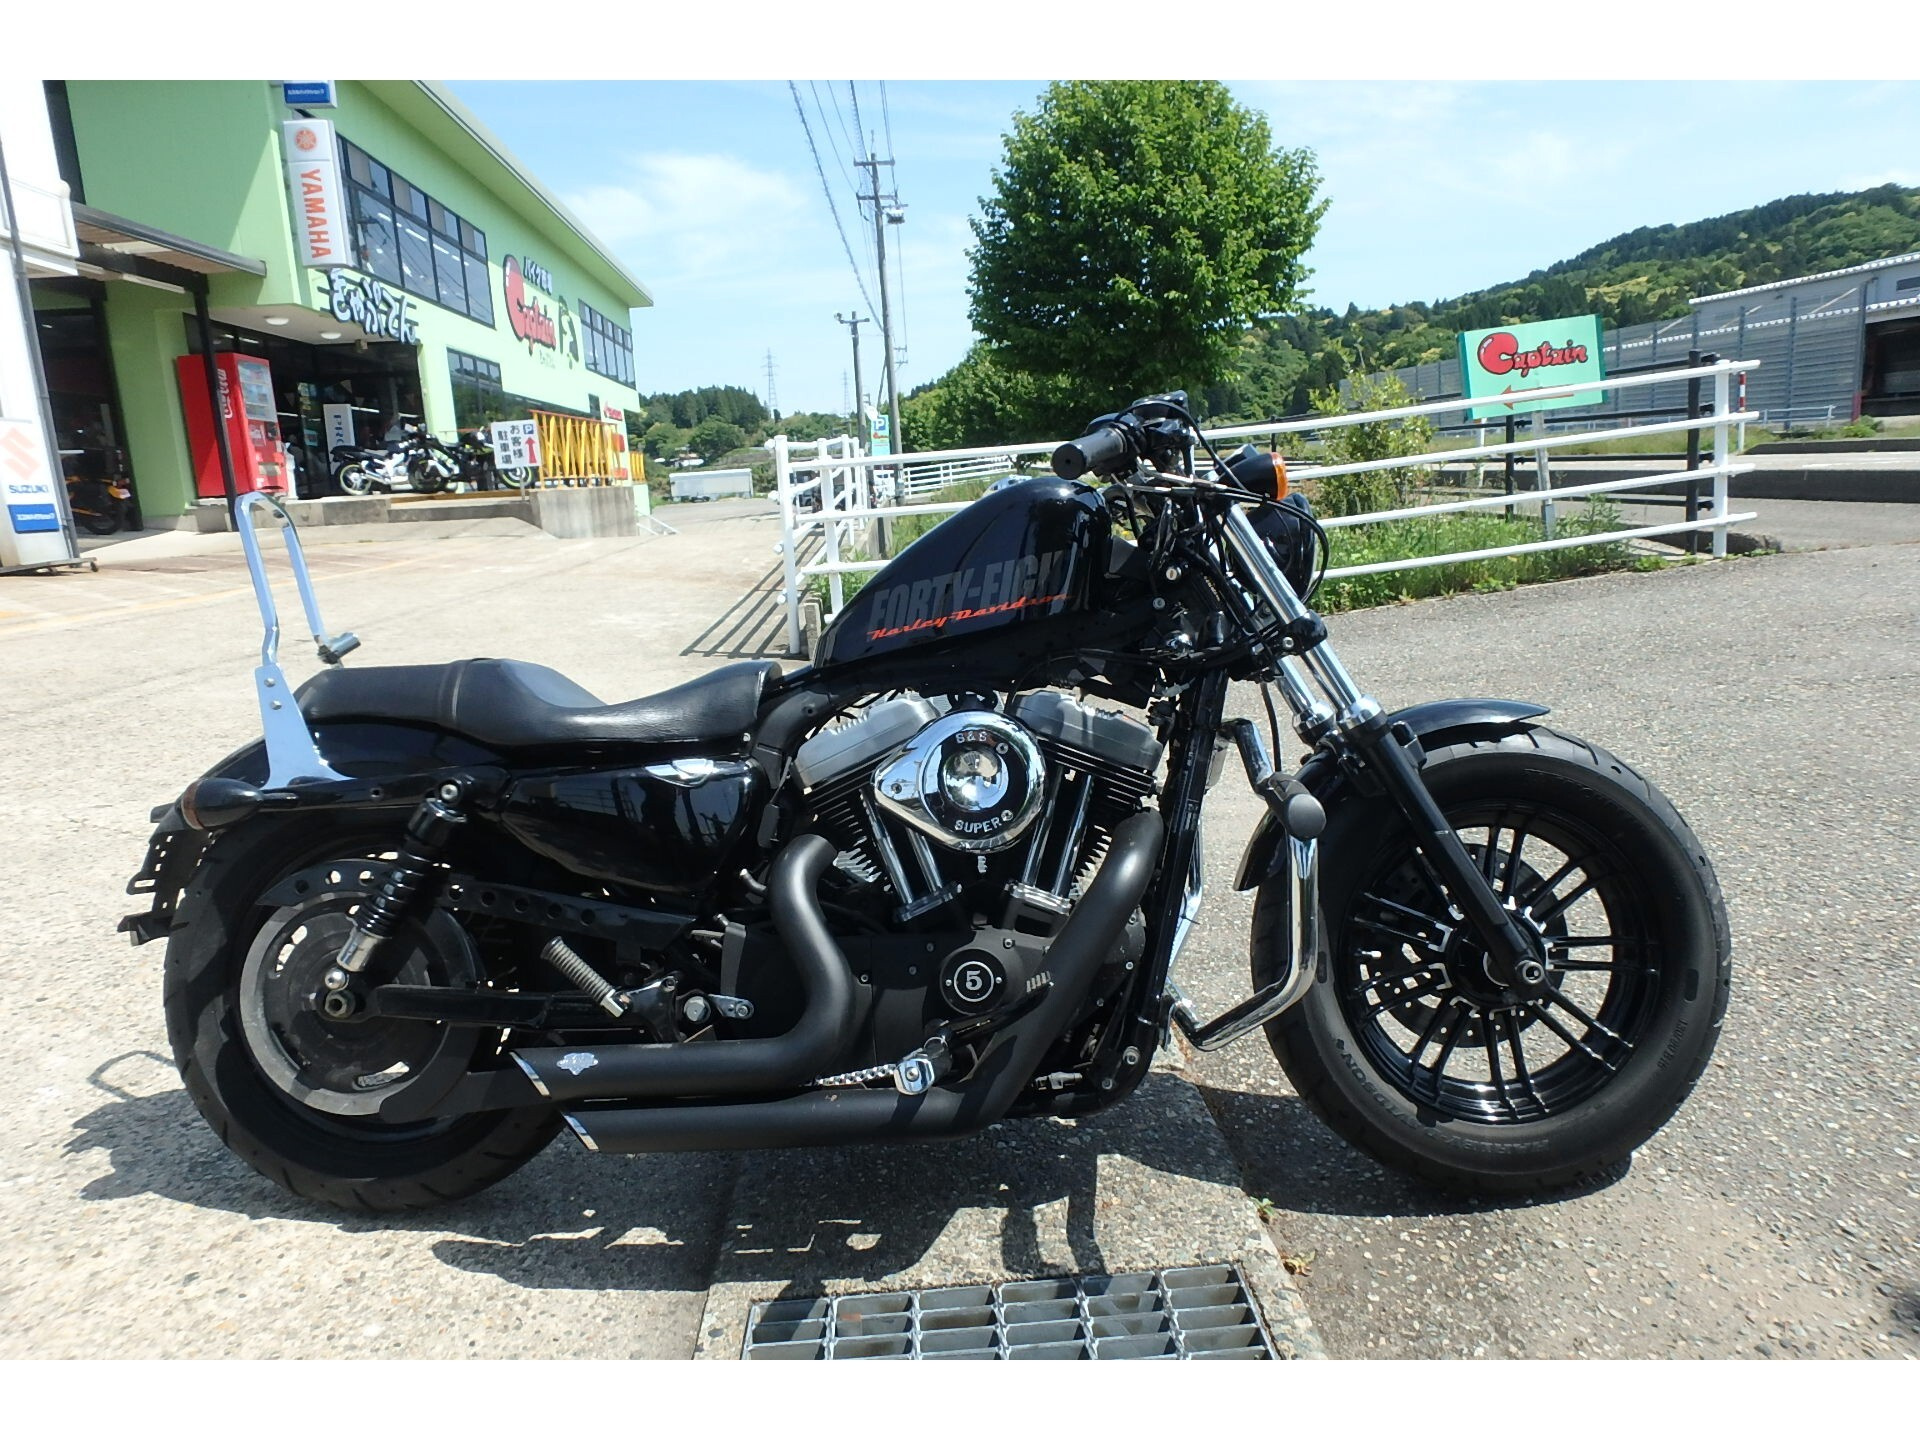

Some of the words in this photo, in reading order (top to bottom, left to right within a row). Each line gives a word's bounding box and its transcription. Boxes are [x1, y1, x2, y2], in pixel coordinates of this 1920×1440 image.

[300, 168, 332, 259] YAMAHA
[1477, 332, 1588, 378] Captain
[8, 484, 49, 494] SUZUKI
[868, 549, 1066, 635] FORTY-EIGH
[955, 730, 988, 744] S&S
[955, 816, 1002, 834] SUPER
[965, 970, 983, 991] 5
